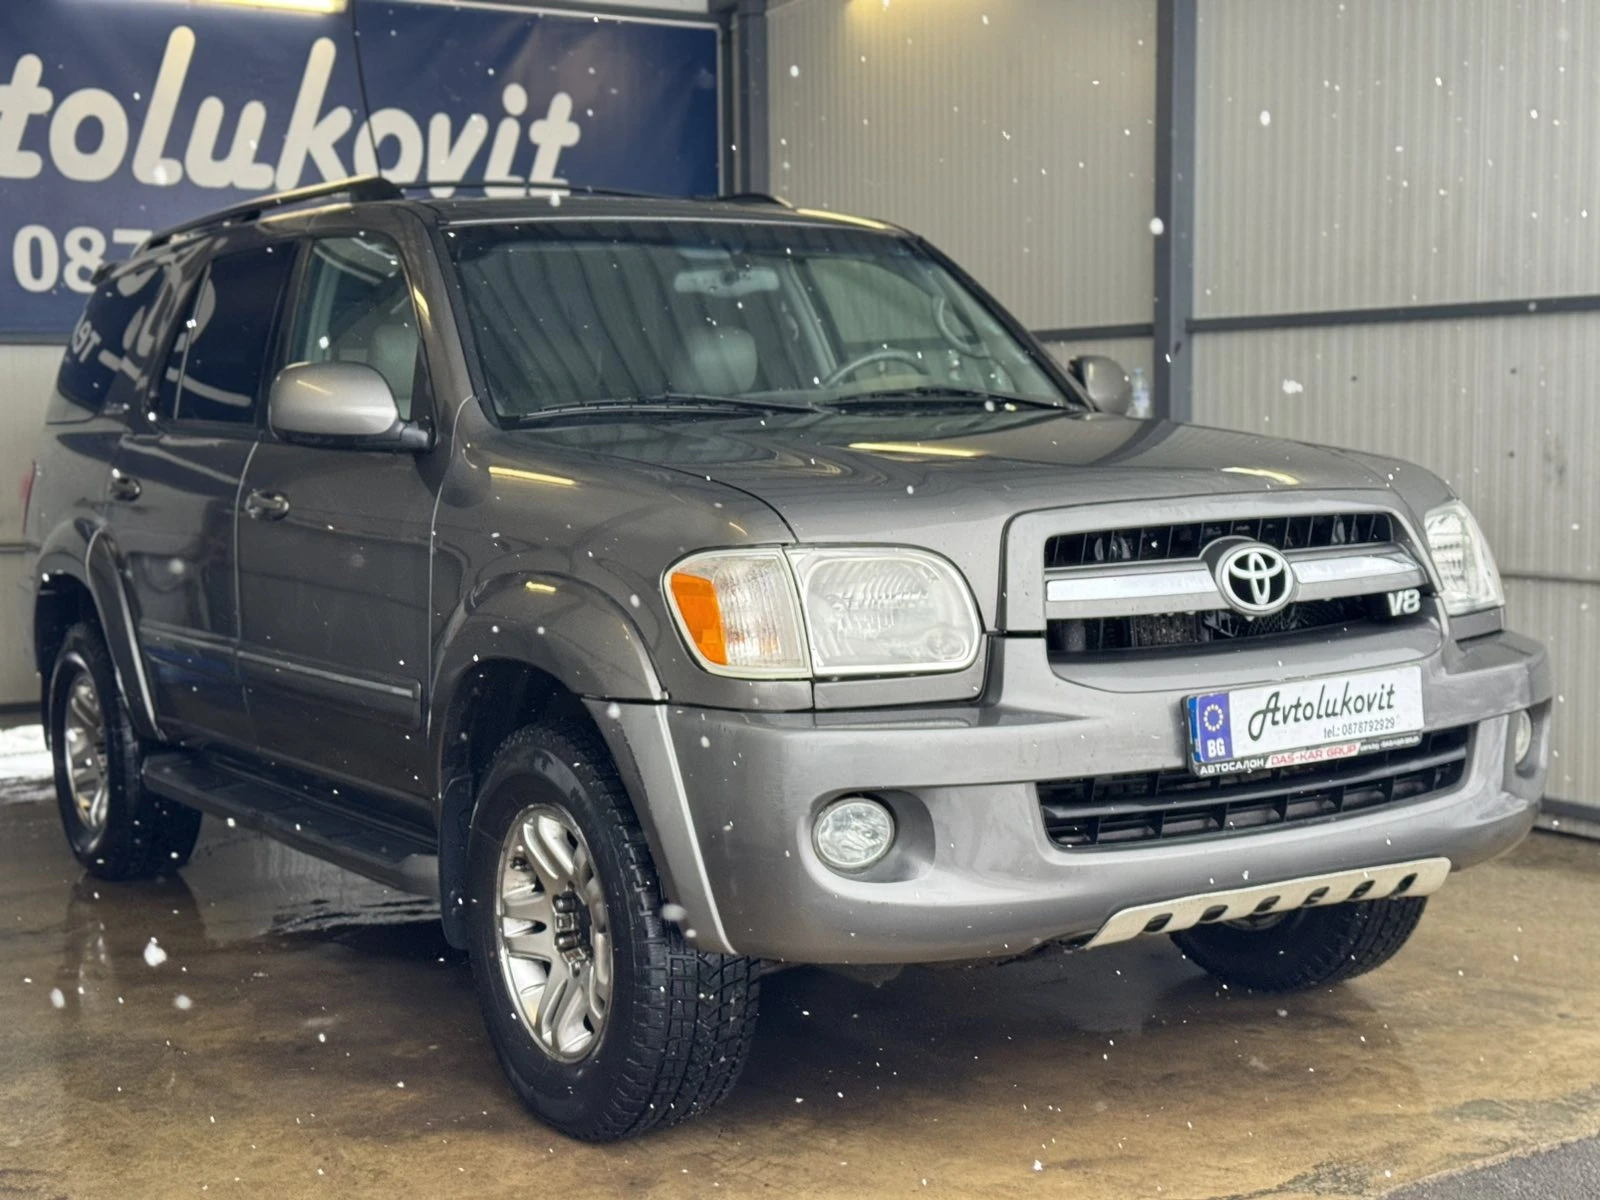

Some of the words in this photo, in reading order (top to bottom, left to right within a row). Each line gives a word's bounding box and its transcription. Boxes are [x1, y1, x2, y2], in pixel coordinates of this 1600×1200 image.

[1387, 588, 1421, 616] V8
[1247, 680, 1395, 741] Avtolukovit
[1207, 737, 1226, 758] BG
